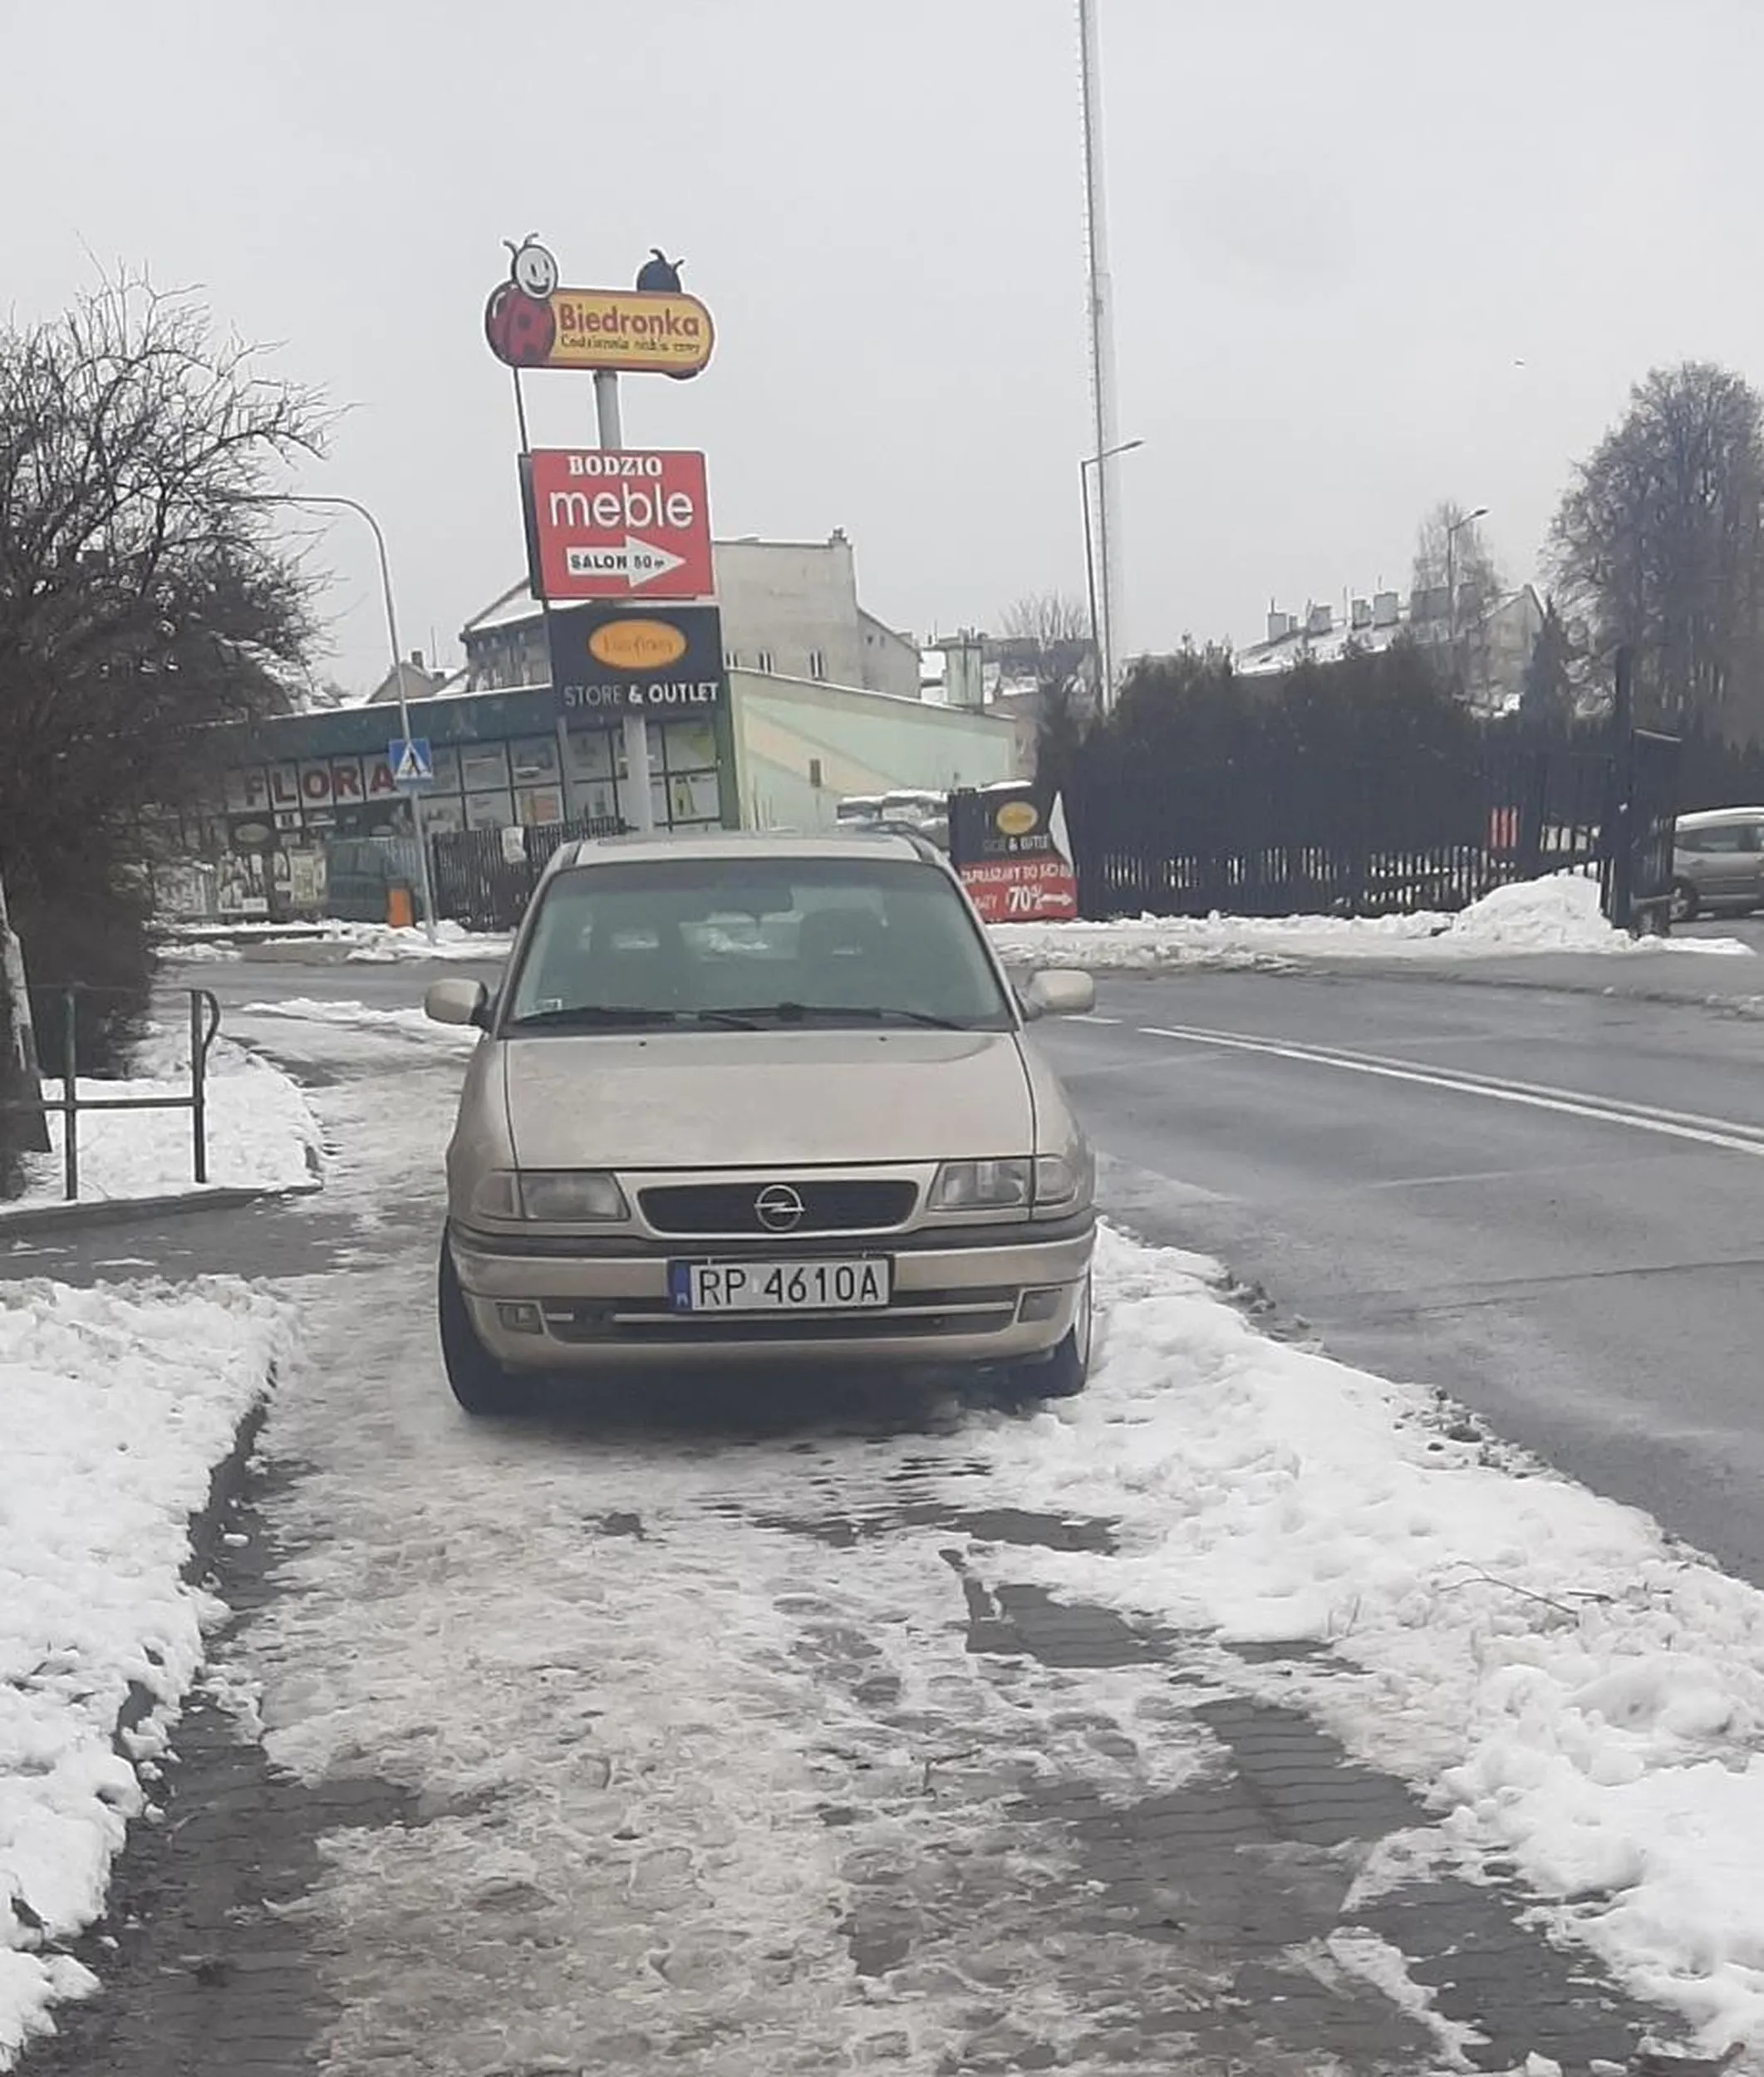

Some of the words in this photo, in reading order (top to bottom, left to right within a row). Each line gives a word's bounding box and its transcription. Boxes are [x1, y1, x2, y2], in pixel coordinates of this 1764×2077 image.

[559, 302, 700, 336] Biedronka
[568, 455, 662, 476] BODZIO
[549, 482, 694, 528] meble
[570, 554, 627, 569] SALON
[564, 684, 622, 706] STORE
[628, 685, 643, 704] &
[649, 682, 719, 703] OUTLET
[245, 762, 398, 806] FLORA
[699, 1269, 746, 1305] RP
[764, 1264, 879, 1304] 4610A
